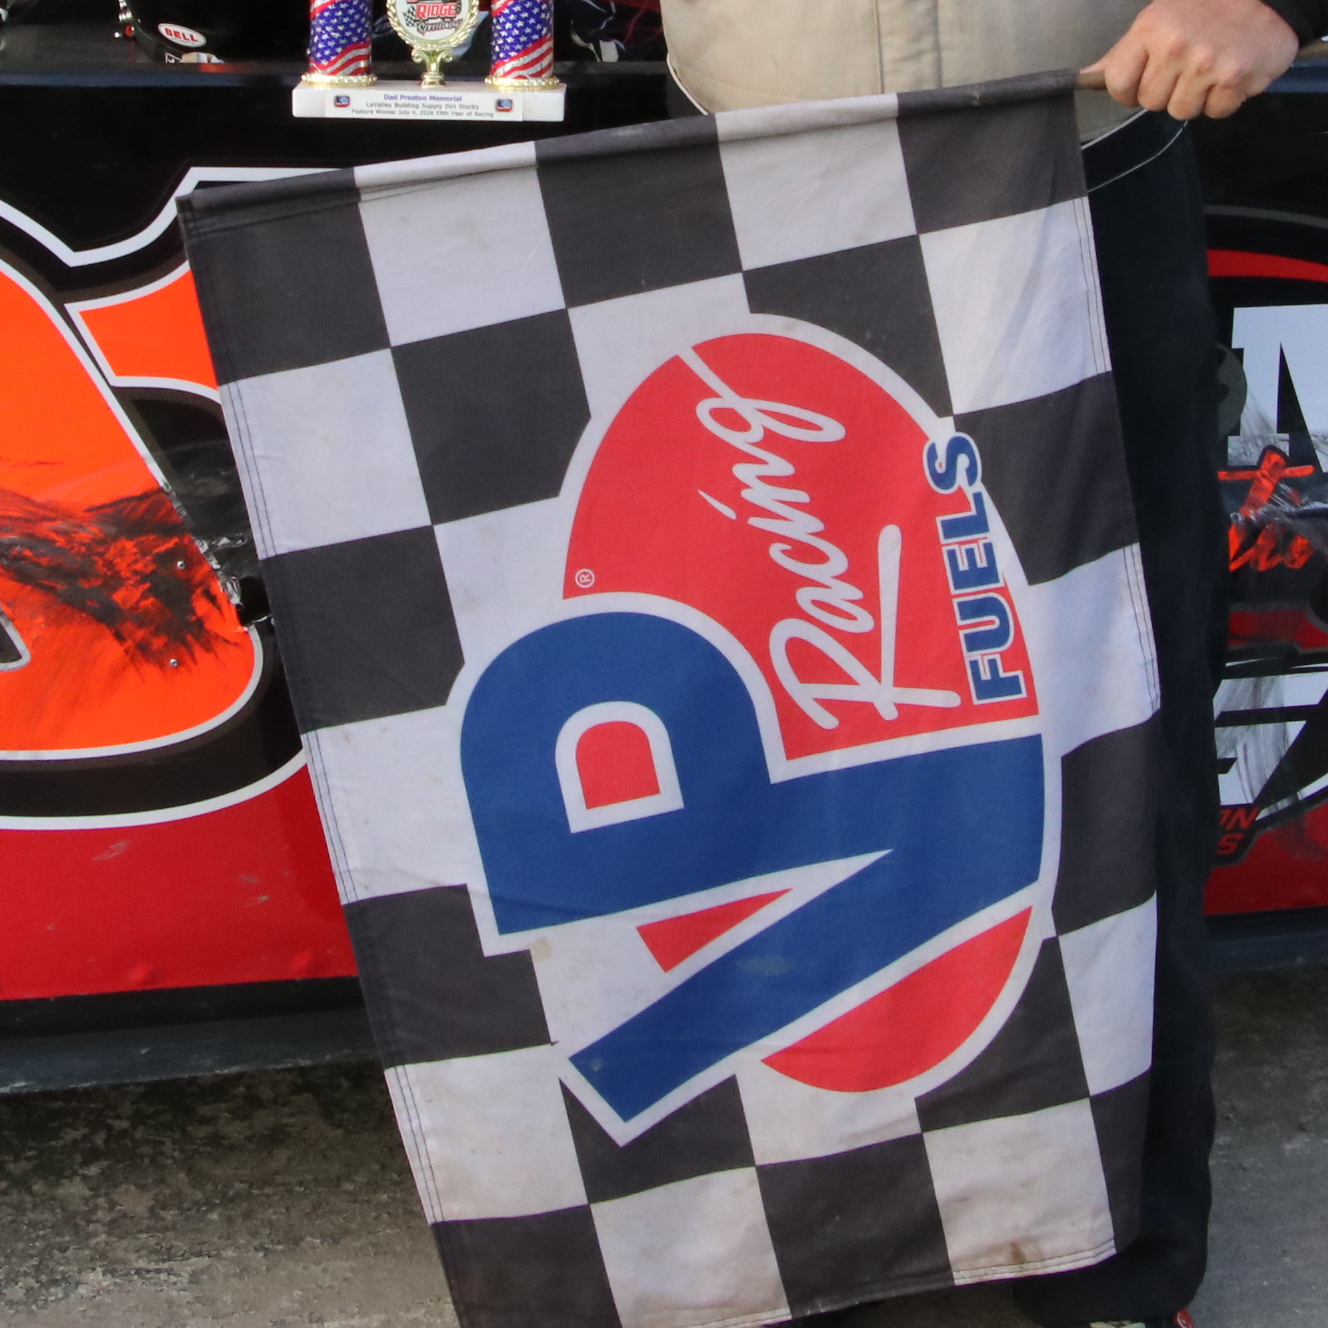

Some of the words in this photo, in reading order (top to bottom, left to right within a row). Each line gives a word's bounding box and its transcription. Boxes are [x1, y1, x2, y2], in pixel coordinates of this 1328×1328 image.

[415, 2, 459, 20] RIDGE
[163, 27, 199, 43] BELL
[384, 93, 398, 101] Dad
[400, 93, 427, 102] Preston
[429, 94, 463, 102] Memorial
[394, 102, 420, 111] Building
[422, 103, 443, 111] Supply
[679, 344, 962, 731] Racing
[923, 431, 1026, 705] FUELS
[460, 610, 1046, 1125] VP
